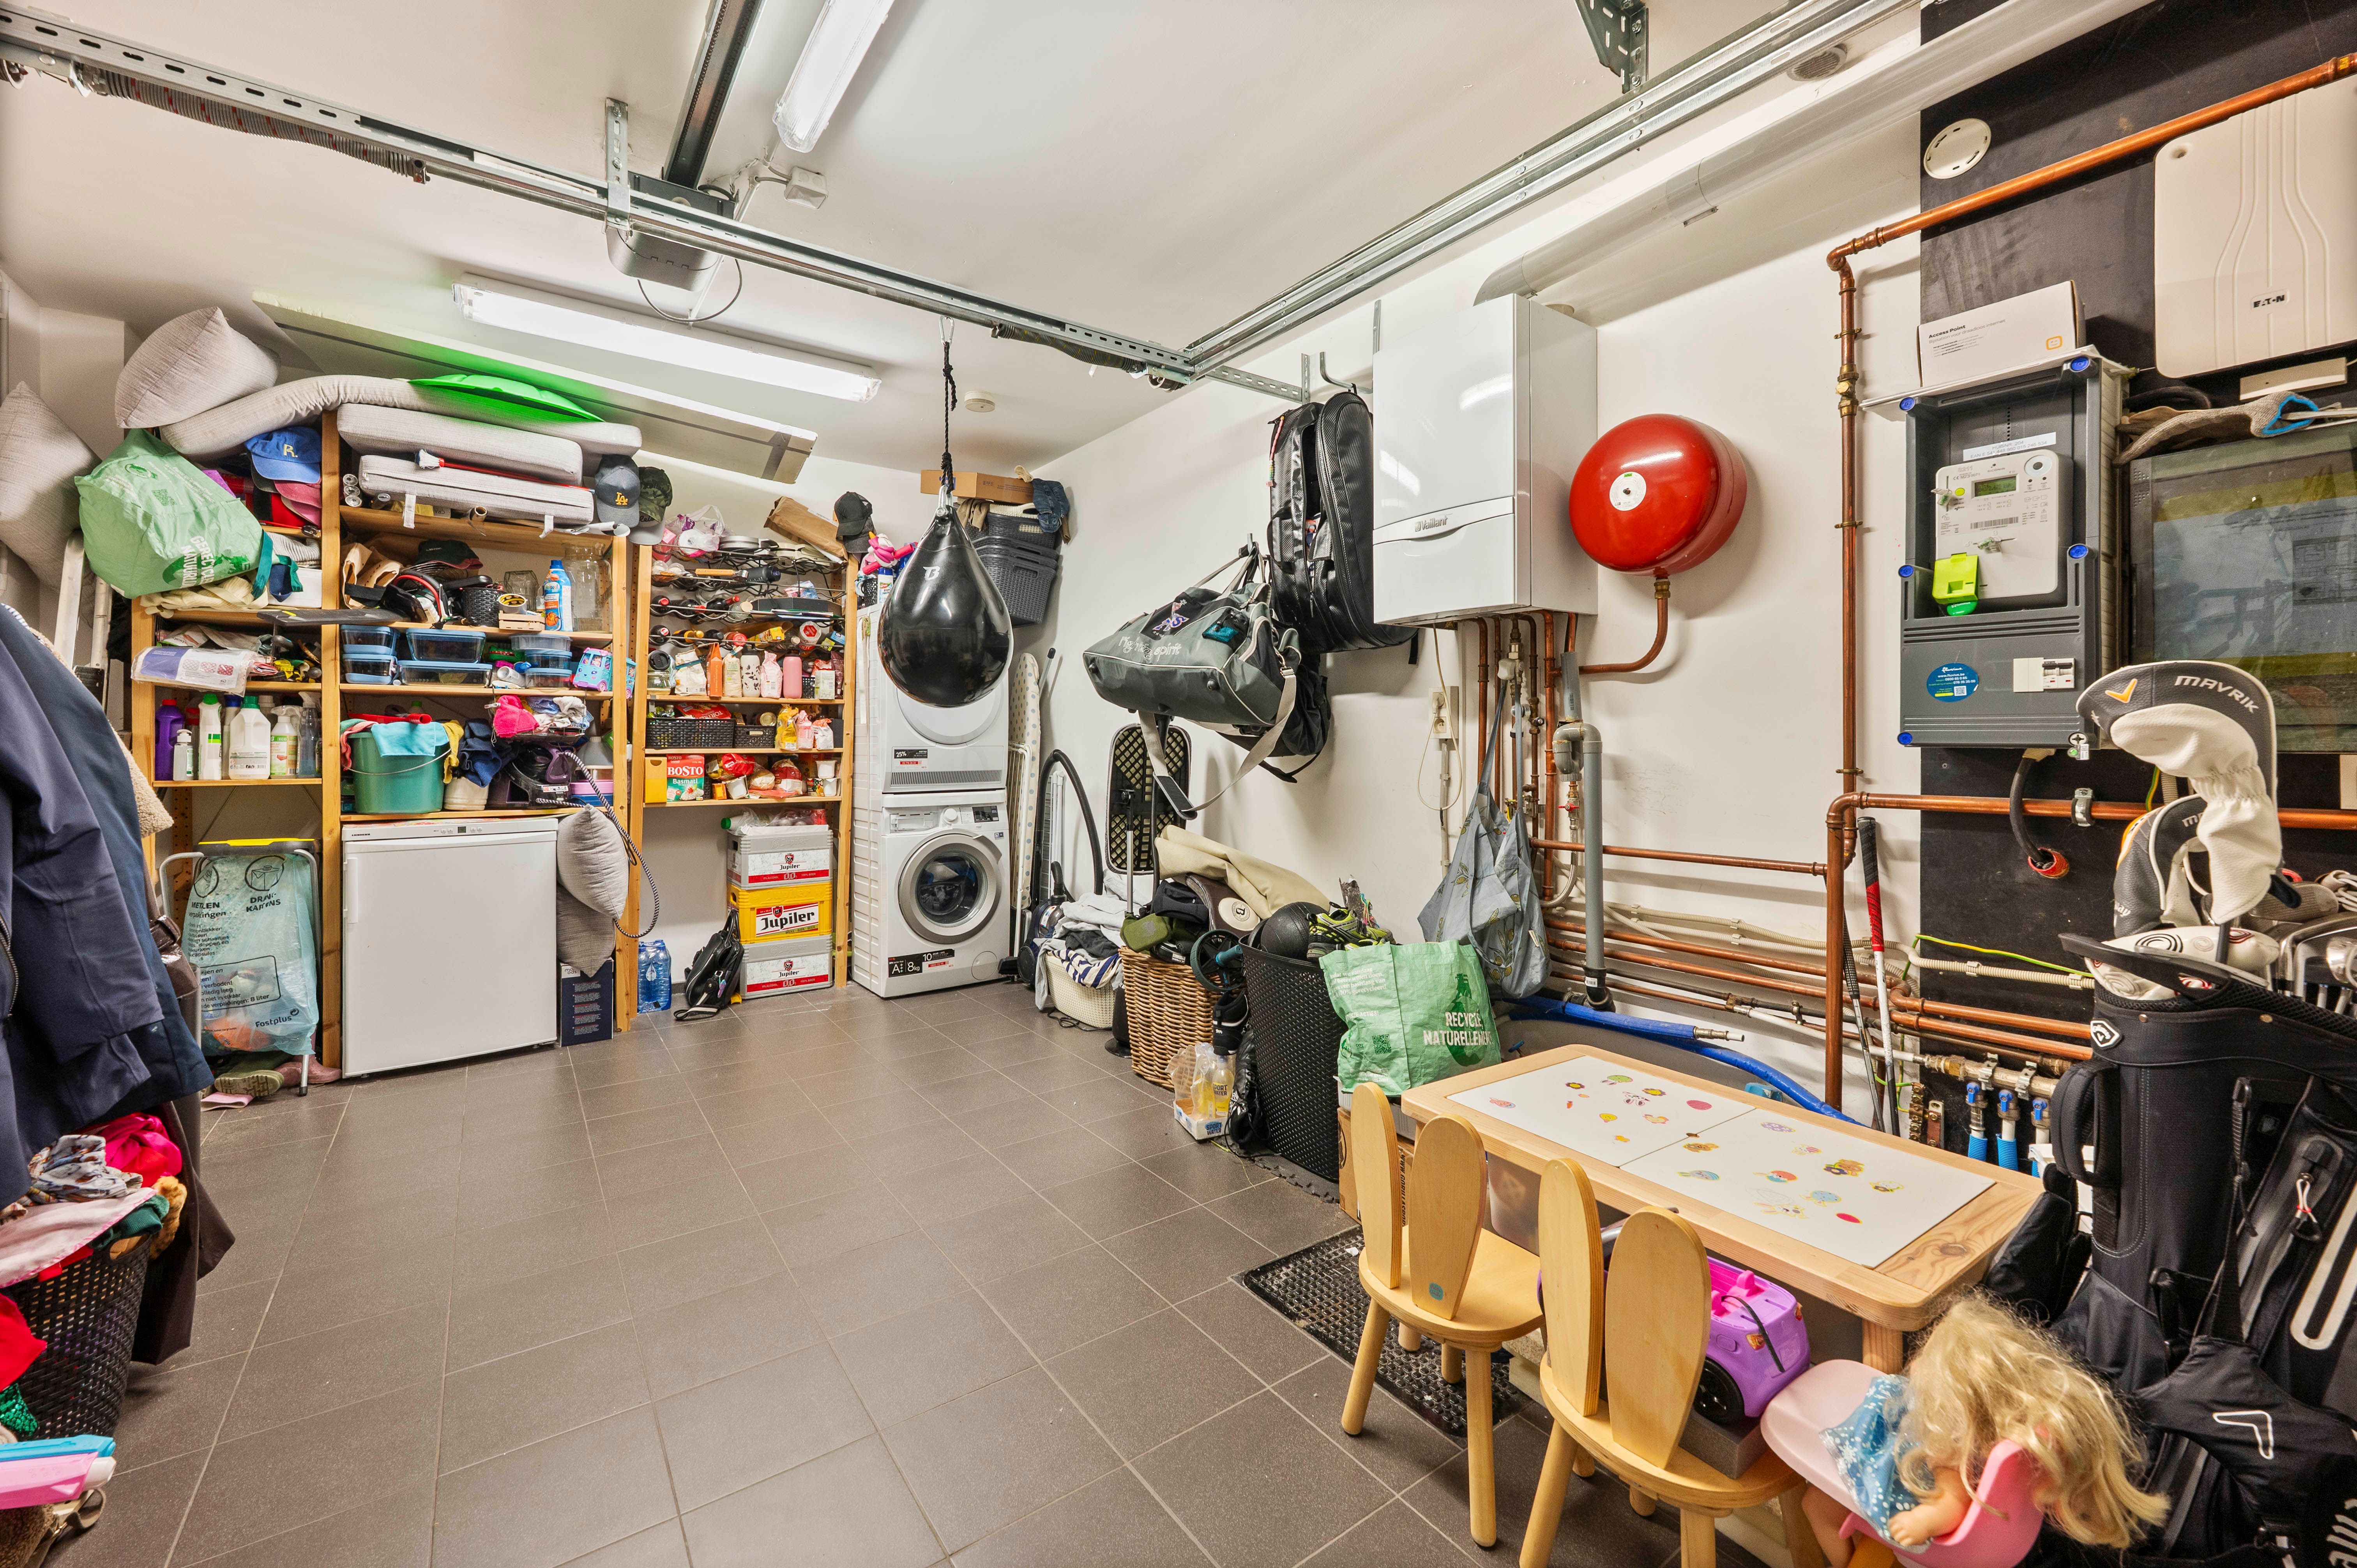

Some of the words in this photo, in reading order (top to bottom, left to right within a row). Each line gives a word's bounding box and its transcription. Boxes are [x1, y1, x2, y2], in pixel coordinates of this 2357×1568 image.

[1929, 330, 1949, 339] Access
[1962, 325, 1986, 334] draadloos
[615, 491, 628, 505] LA
[1422, 515, 1448, 530] Vaillant
[1154, 643, 1182, 662] spirit
[2174, 676, 2259, 713] MAVRIK
[667, 766, 703, 776] BOSTO
[760, 912, 815, 931] Jupiler
[923, 953, 932, 961] 10
[255, 1016, 292, 1028] Fostplus
